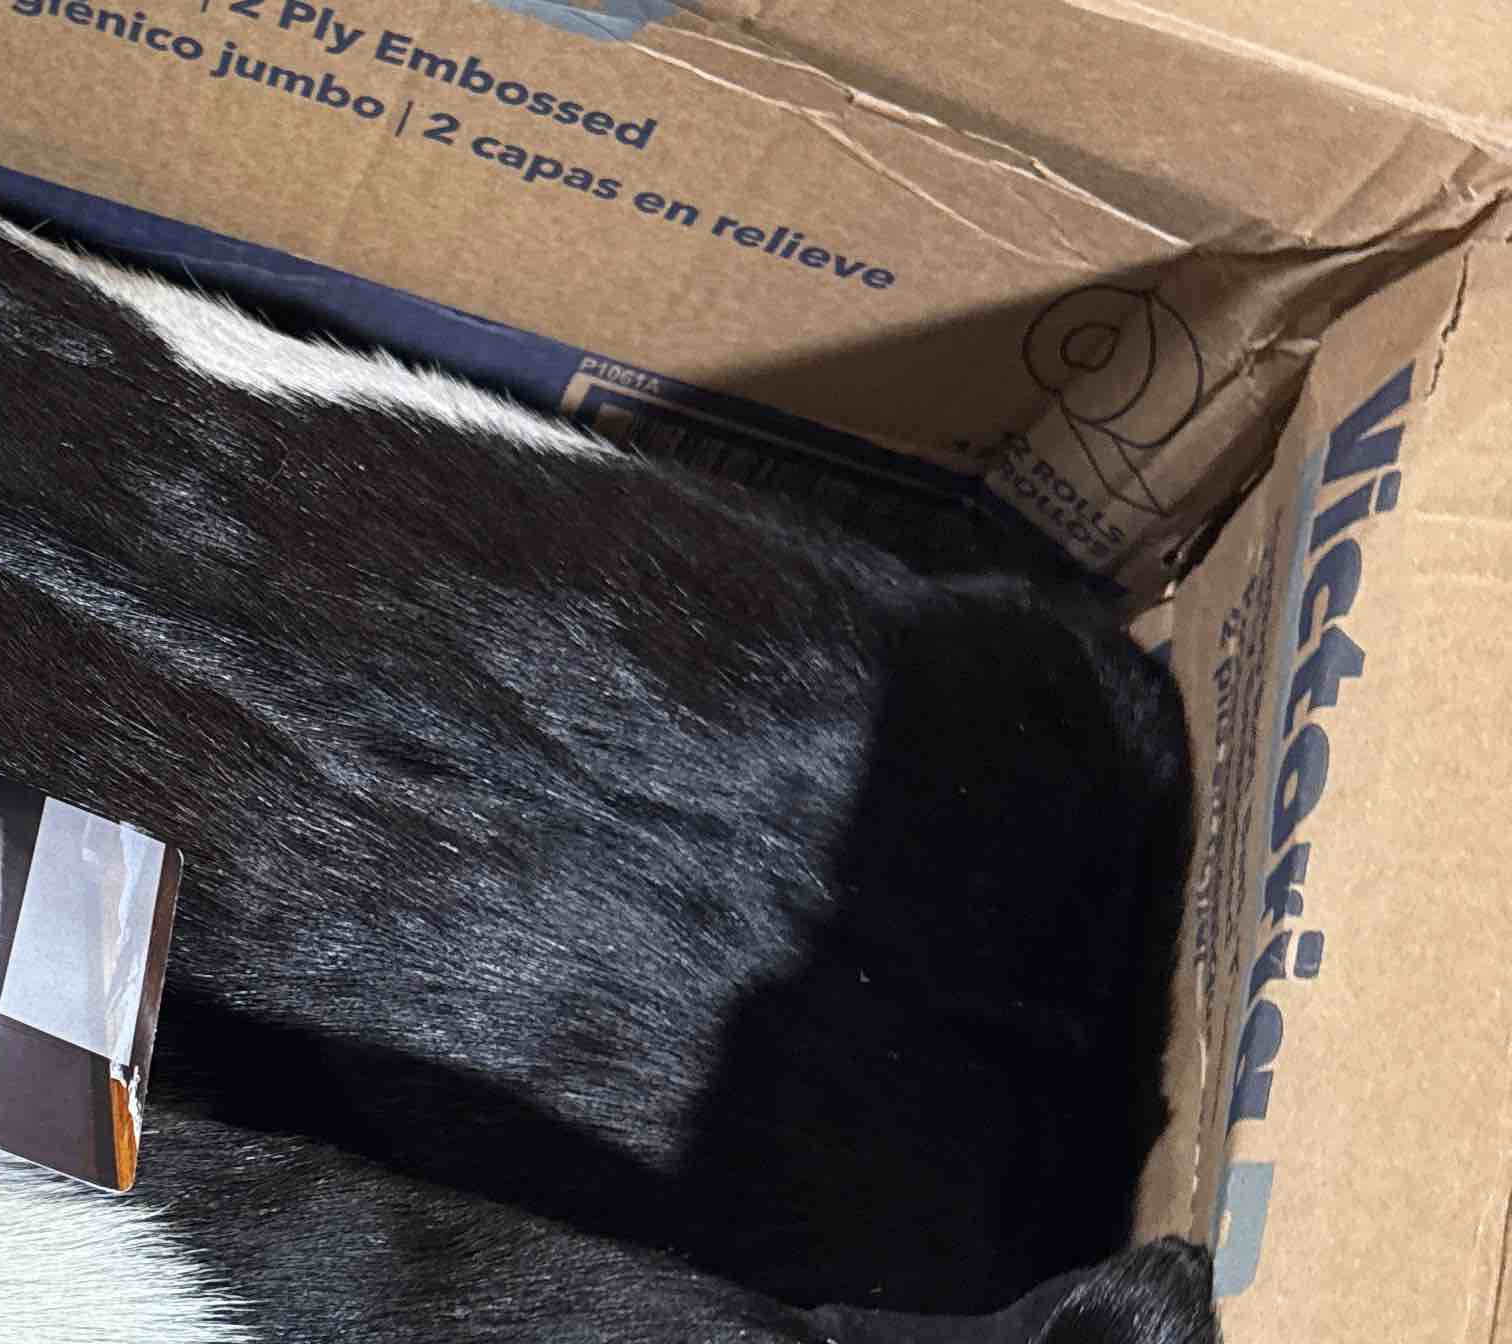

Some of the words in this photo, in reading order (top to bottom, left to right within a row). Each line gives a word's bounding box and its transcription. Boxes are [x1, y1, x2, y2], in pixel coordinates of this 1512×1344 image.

[210, 39, 385, 120] jumbo
[423, 111, 460, 146] 2
[472, 134, 624, 203] capas
[632, 186, 701, 228] en
[708, 212, 898, 292] relieve
[374, 33, 658, 150] Embossed
